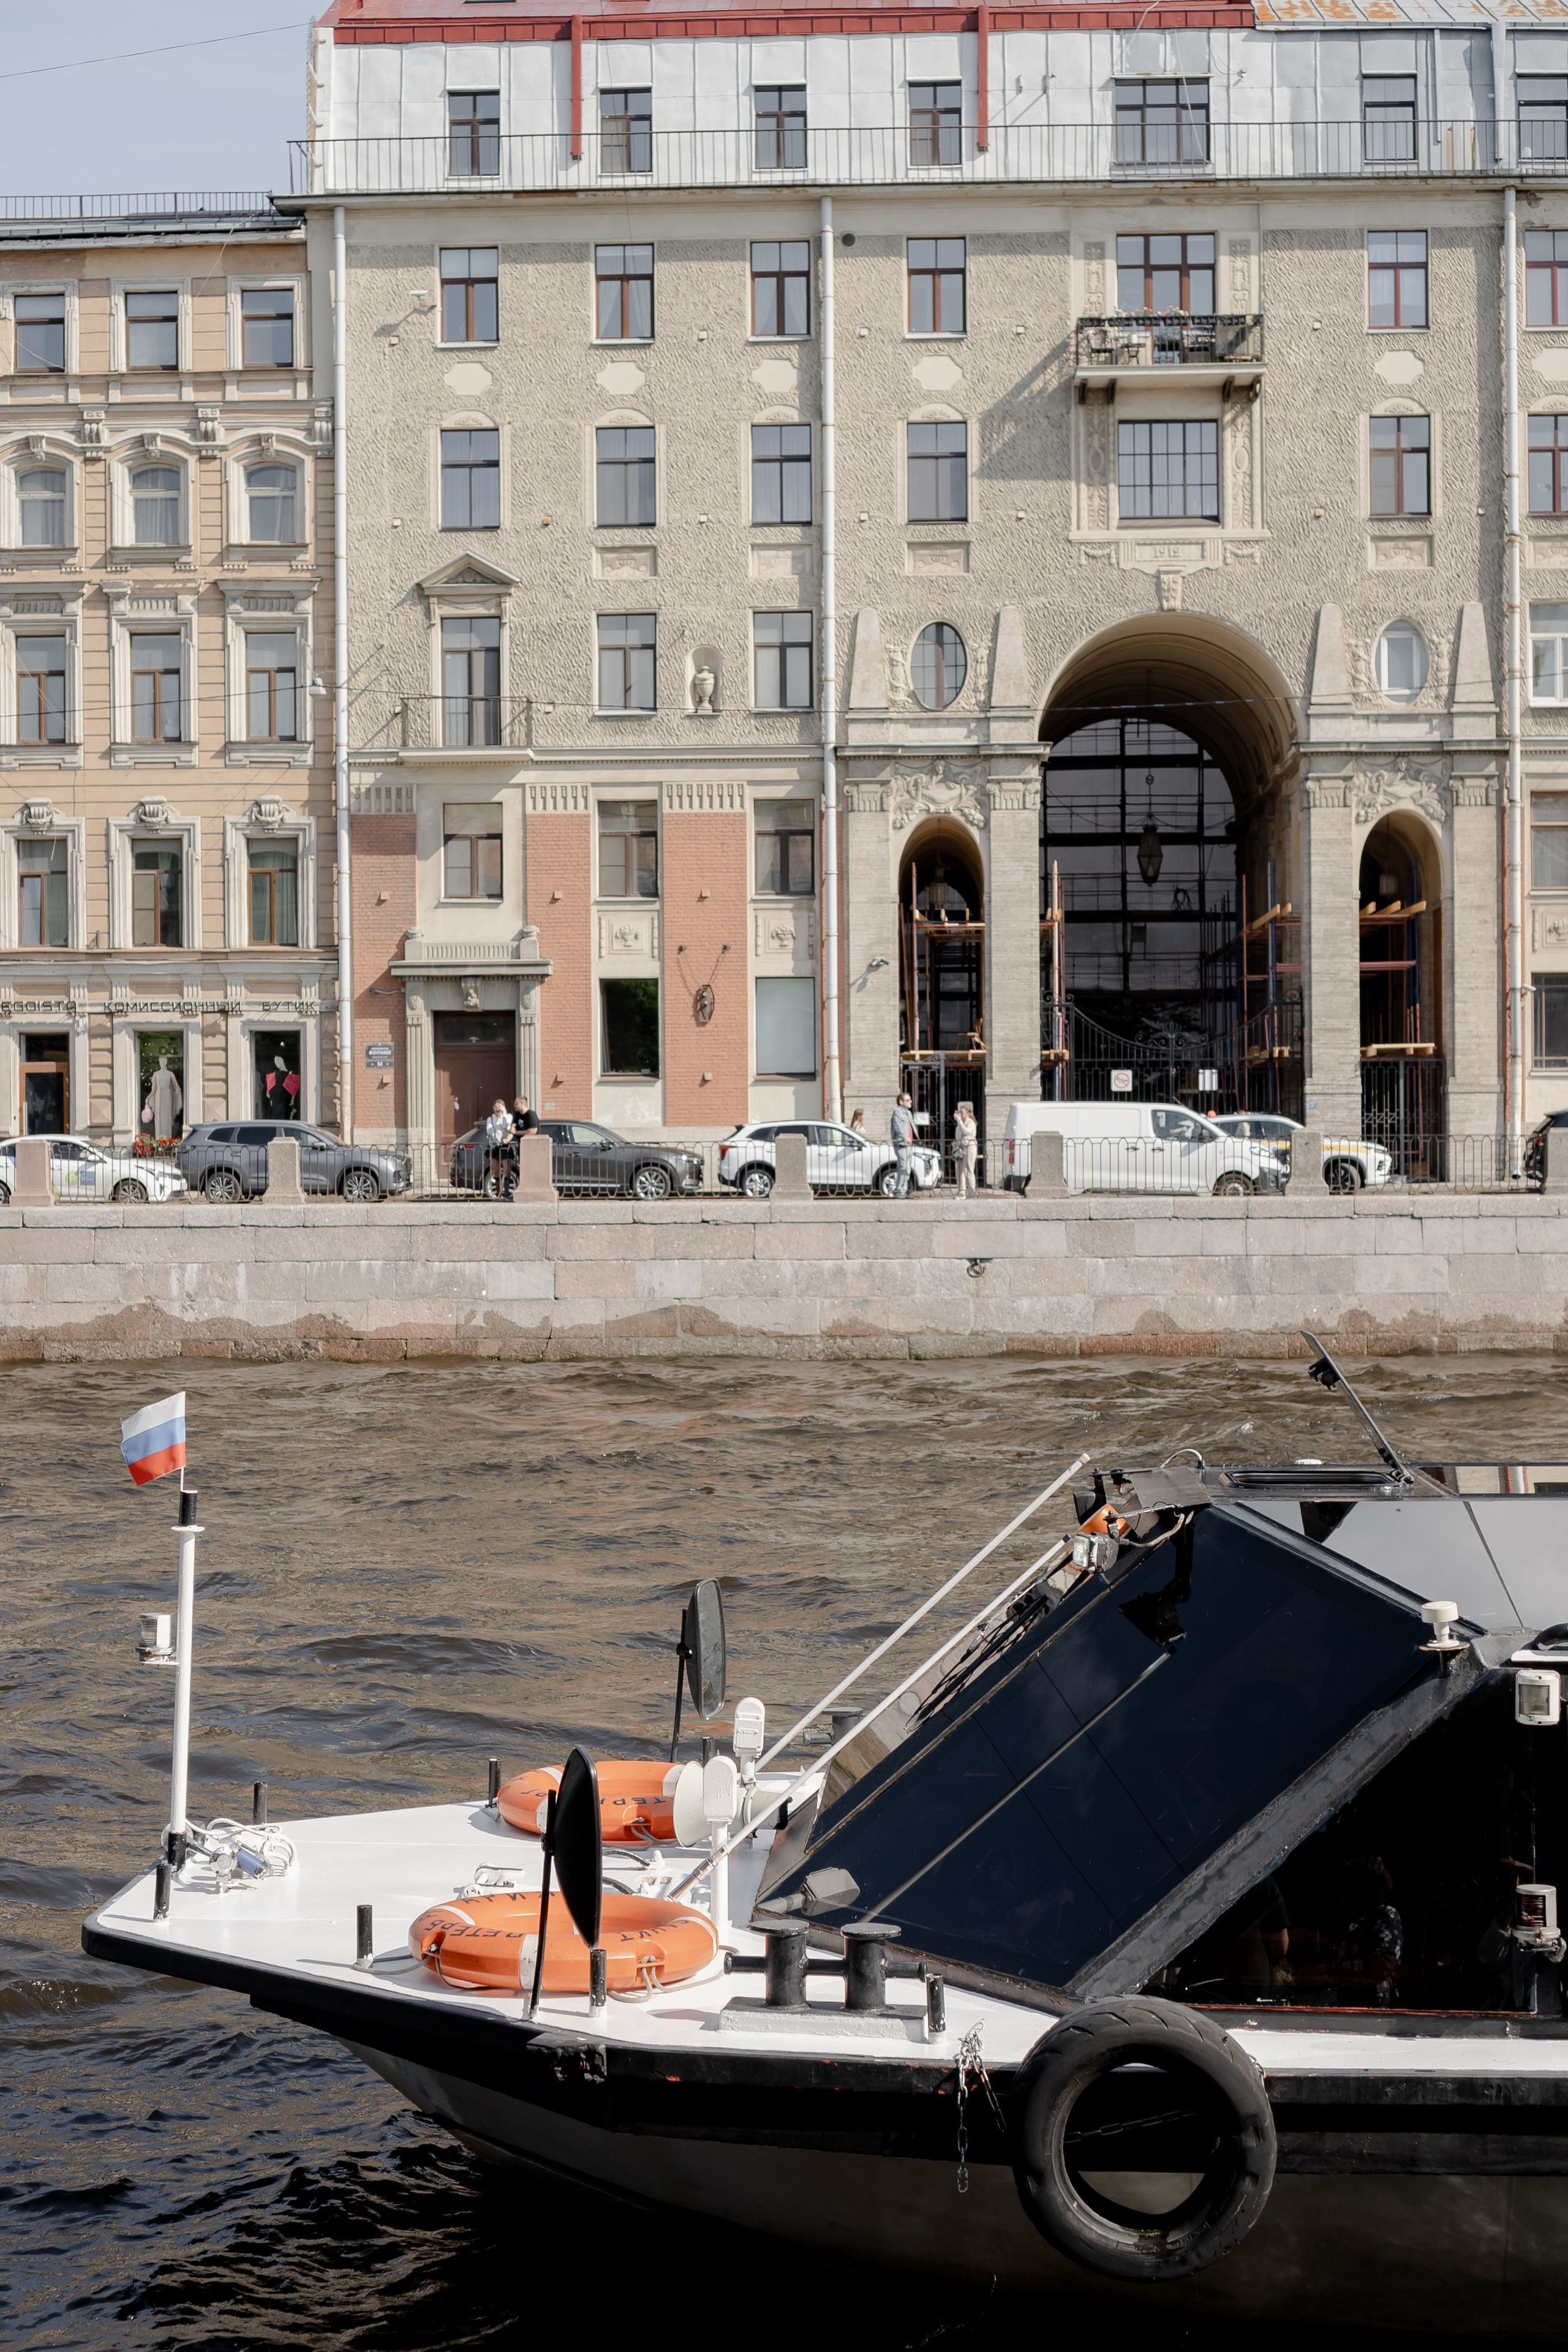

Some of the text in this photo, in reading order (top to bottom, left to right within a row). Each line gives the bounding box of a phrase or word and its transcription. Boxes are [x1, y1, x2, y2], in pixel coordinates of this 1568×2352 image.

[1, 1001, 77, 1011] EGOISTA
[104, 999, 315, 1011] КОМИССИОННЫЙ БУТИК
